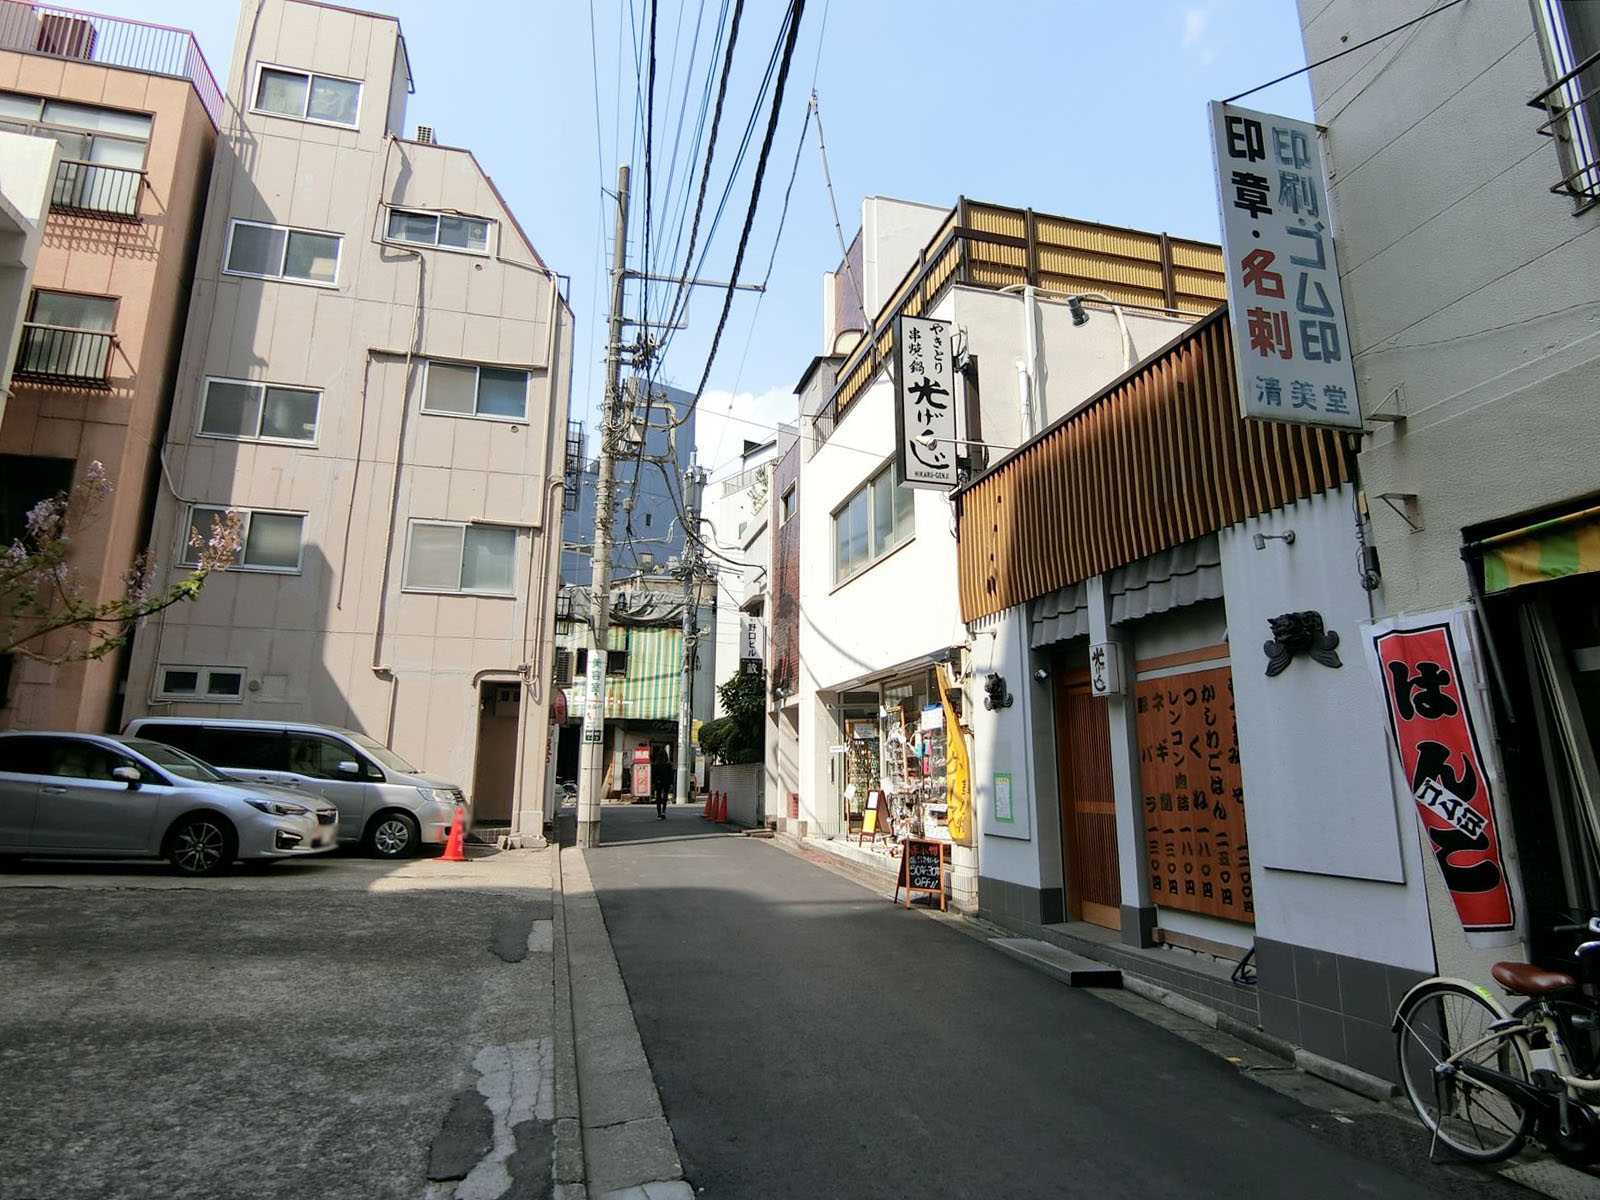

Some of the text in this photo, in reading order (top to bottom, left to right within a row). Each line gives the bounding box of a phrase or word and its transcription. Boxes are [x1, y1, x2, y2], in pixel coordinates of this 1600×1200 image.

[929, 322, 945, 375] やきとり
[1255, 375, 1350, 415] 清美堂
[1183, 688, 1208, 810] つくね
[1200, 684, 1227, 820] かしわごはん
[1387, 660, 1500, 893] はんこ
